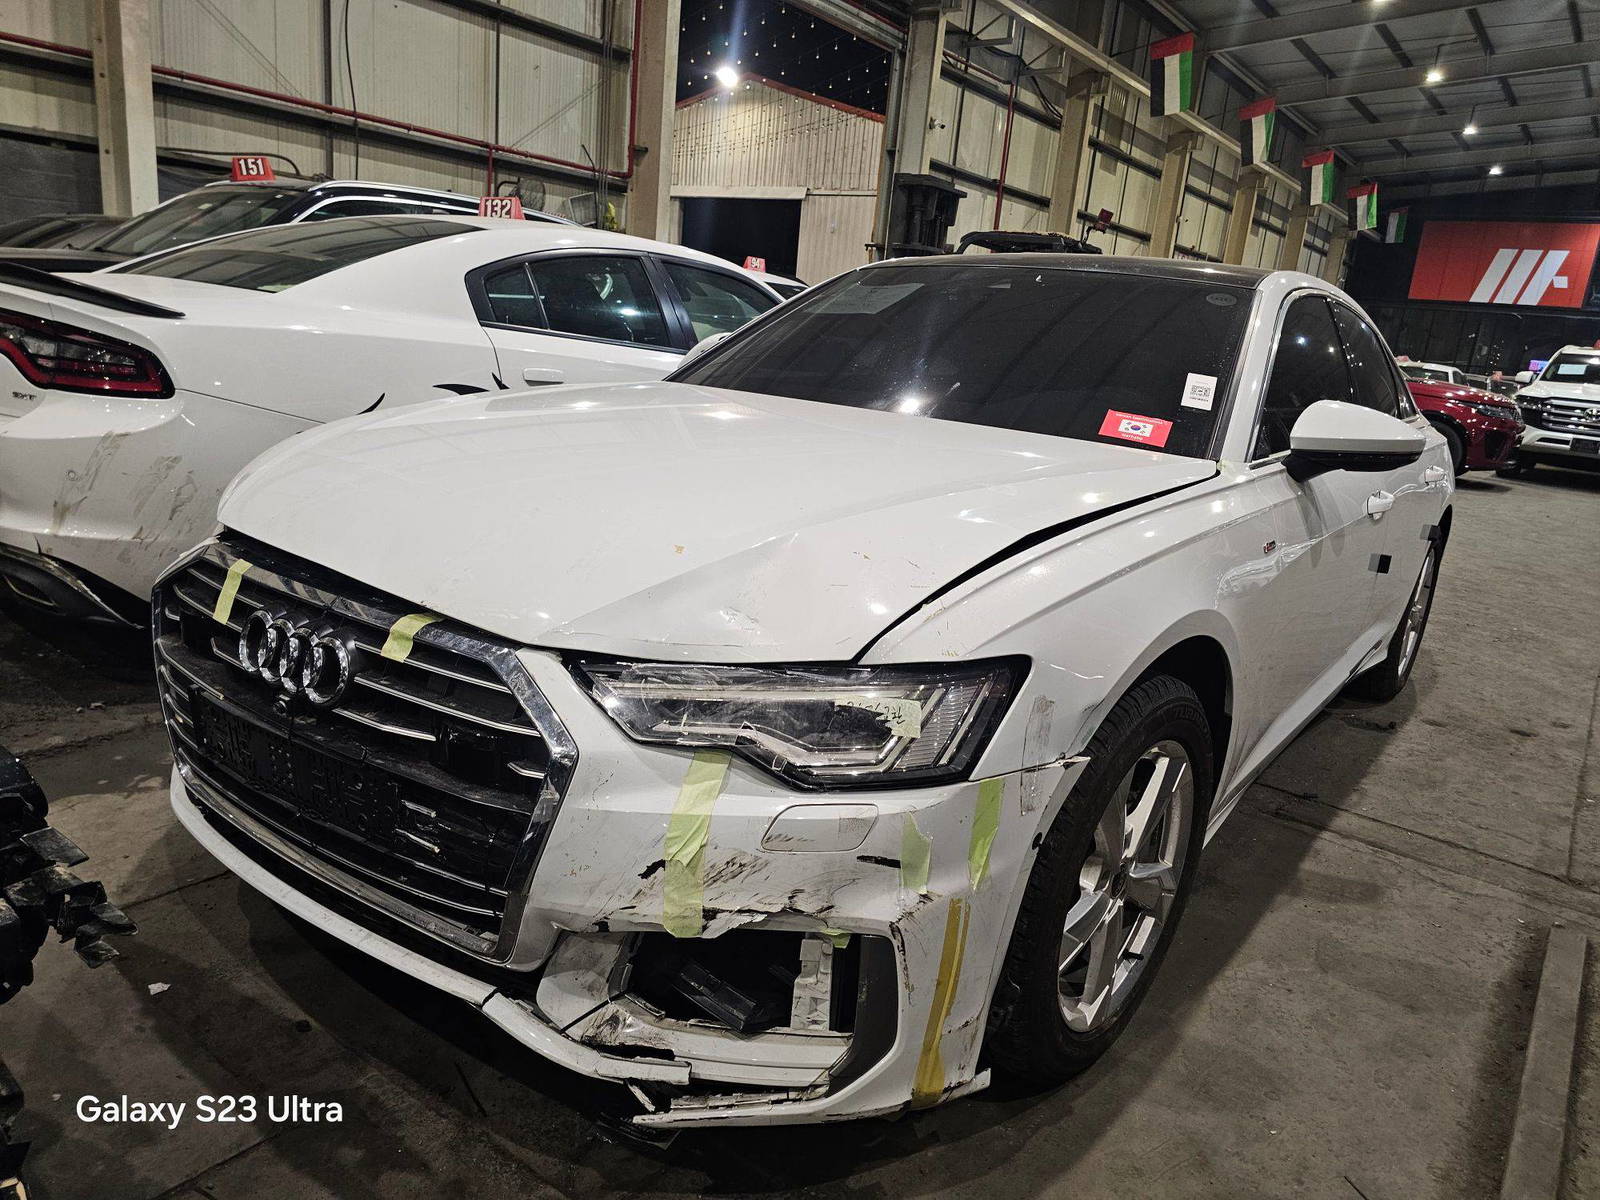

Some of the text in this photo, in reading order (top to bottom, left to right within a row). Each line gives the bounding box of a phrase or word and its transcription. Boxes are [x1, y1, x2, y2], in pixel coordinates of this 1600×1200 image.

[239, 158, 265, 176] 151
[486, 199, 511, 218] 132
[751, 256, 761, 269] 94
